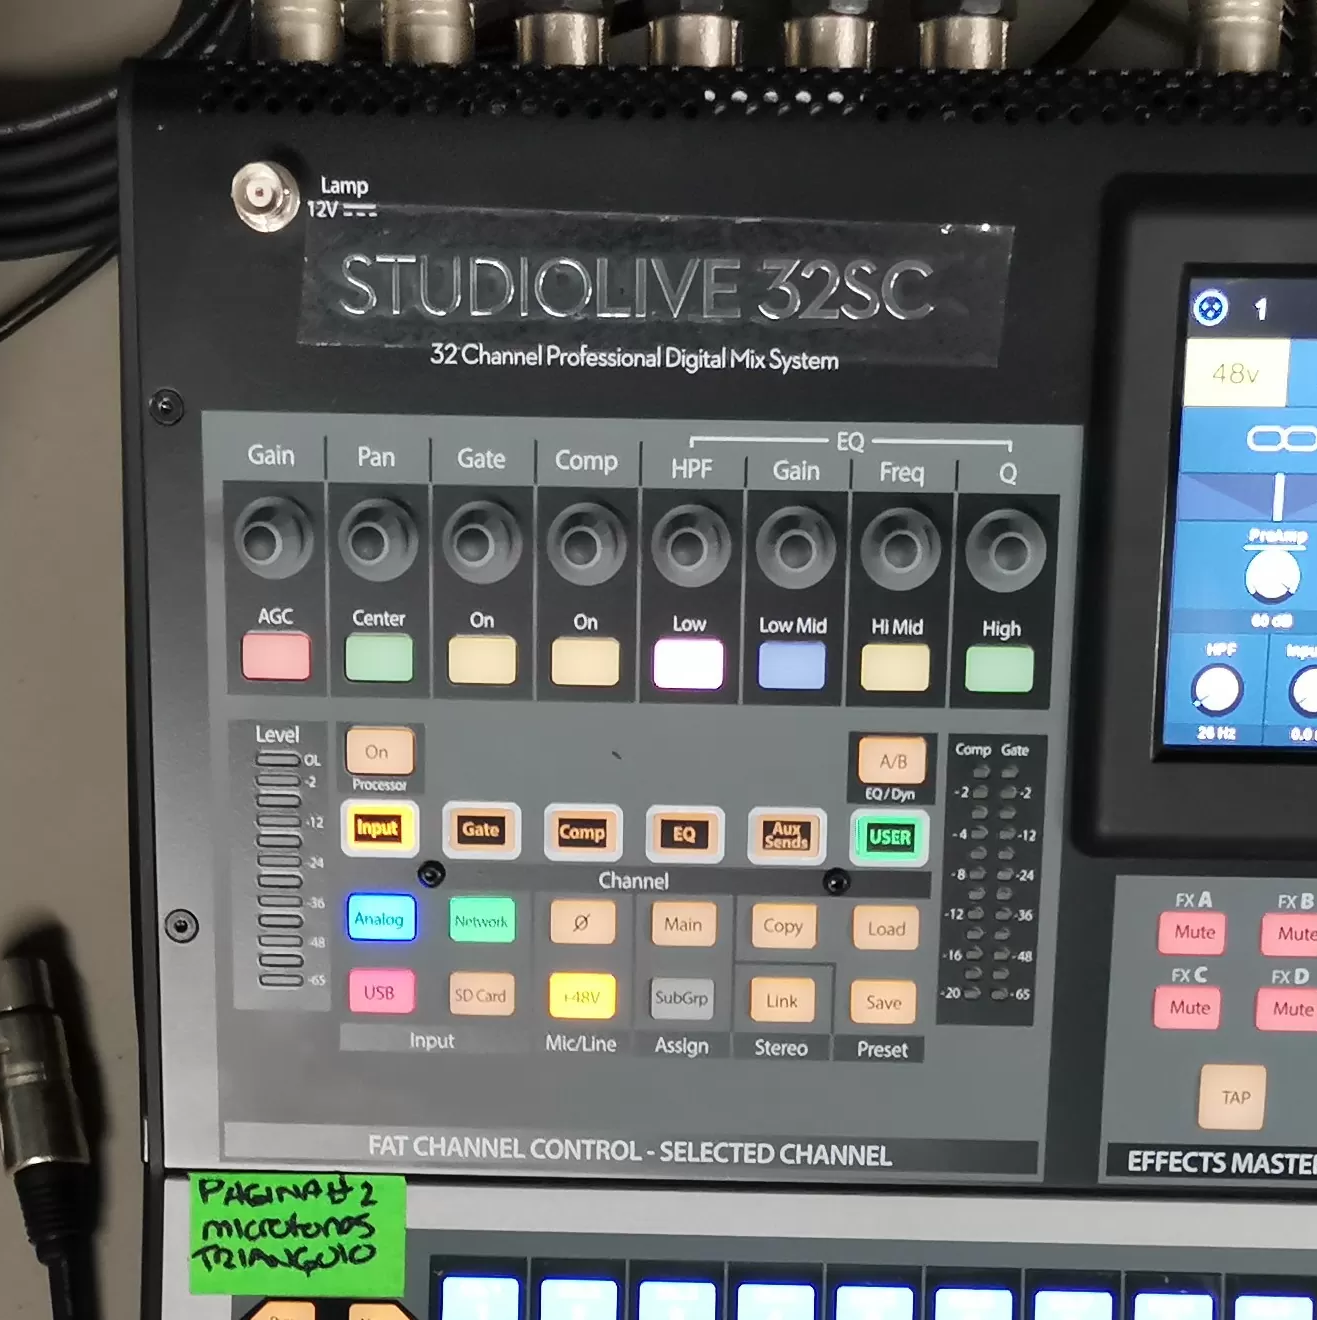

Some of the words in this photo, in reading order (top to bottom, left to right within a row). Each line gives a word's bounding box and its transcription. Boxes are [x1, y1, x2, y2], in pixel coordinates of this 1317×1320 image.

[321, 175, 369, 199] Lamp
[306, 199, 341, 218] 12V
[339, 253, 741, 322] STUDIOLIVE
[757, 258, 935, 321] 32SC
[429, 342, 462, 365] 32
[458, 342, 543, 367] Channel
[546, 343, 662, 368] Professional
[665, 345, 727, 375] Digital
[730, 347, 767, 370] Mix
[768, 348, 840, 376] System
[1212, 362, 1260, 385] 48v
[836, 430, 865, 454] EQ
[247, 443, 295, 468] Gain
[358, 445, 396, 468] Pan
[457, 446, 506, 470] Gate
[555, 448, 619, 476] Comp
[671, 457, 714, 480] HPF
[772, 459, 821, 481] Gain
[880, 460, 925, 489] Freq
[999, 461, 1018, 486] Q
[257, 607, 294, 625] AGC
[352, 608, 407, 627] Center
[469, 610, 495, 629] On
[573, 612, 599, 631] On
[672, 614, 708, 633] Low
[759, 616, 795, 634] Low
[795, 616, 828, 635] Mid
[871, 617, 890, 635] Hi
[892, 618, 924, 636] Mid
[982, 619, 1022, 642] High
[255, 724, 300, 751] Level
[364, 743, 389, 760] On
[354, 816, 400, 844] Input
[461, 820, 500, 838] Gate
[556, 820, 608, 848] Comp
[670, 825, 700, 850] EQ
[866, 824, 912, 846] USER
[598, 870, 670, 891] Channel
[1175, 892, 1195, 908] FX
[1197, 890, 1213, 909] A
[354, 911, 404, 930] Analog
[664, 916, 703, 932] Main
[763, 917, 804, 938] Copy
[868, 920, 907, 937] Load
[1174, 923, 1216, 940] Mute
[364, 984, 395, 1001] USB
[455, 987, 474, 1003] SD
[475, 988, 507, 1004] Card
[766, 993, 798, 1009] Link
[866, 994, 903, 1011] Save
[409, 1031, 456, 1052] Input
[545, 1033, 617, 1053] Mic/Line
[654, 1036, 710, 1059] Assign
[754, 1038, 809, 1057] Stereo
[857, 1040, 909, 1059] Preset
[1221, 1090, 1252, 1105] TAP
[368, 1134, 410, 1157] FAT
[411, 1134, 532, 1160] CHANNEL
[530, 1137, 645, 1162] CONTROL
[659, 1140, 777, 1165] SELECTED
[779, 1142, 895, 1167] CHANNEL
[1125, 1149, 1227, 1179] EFFECTS
